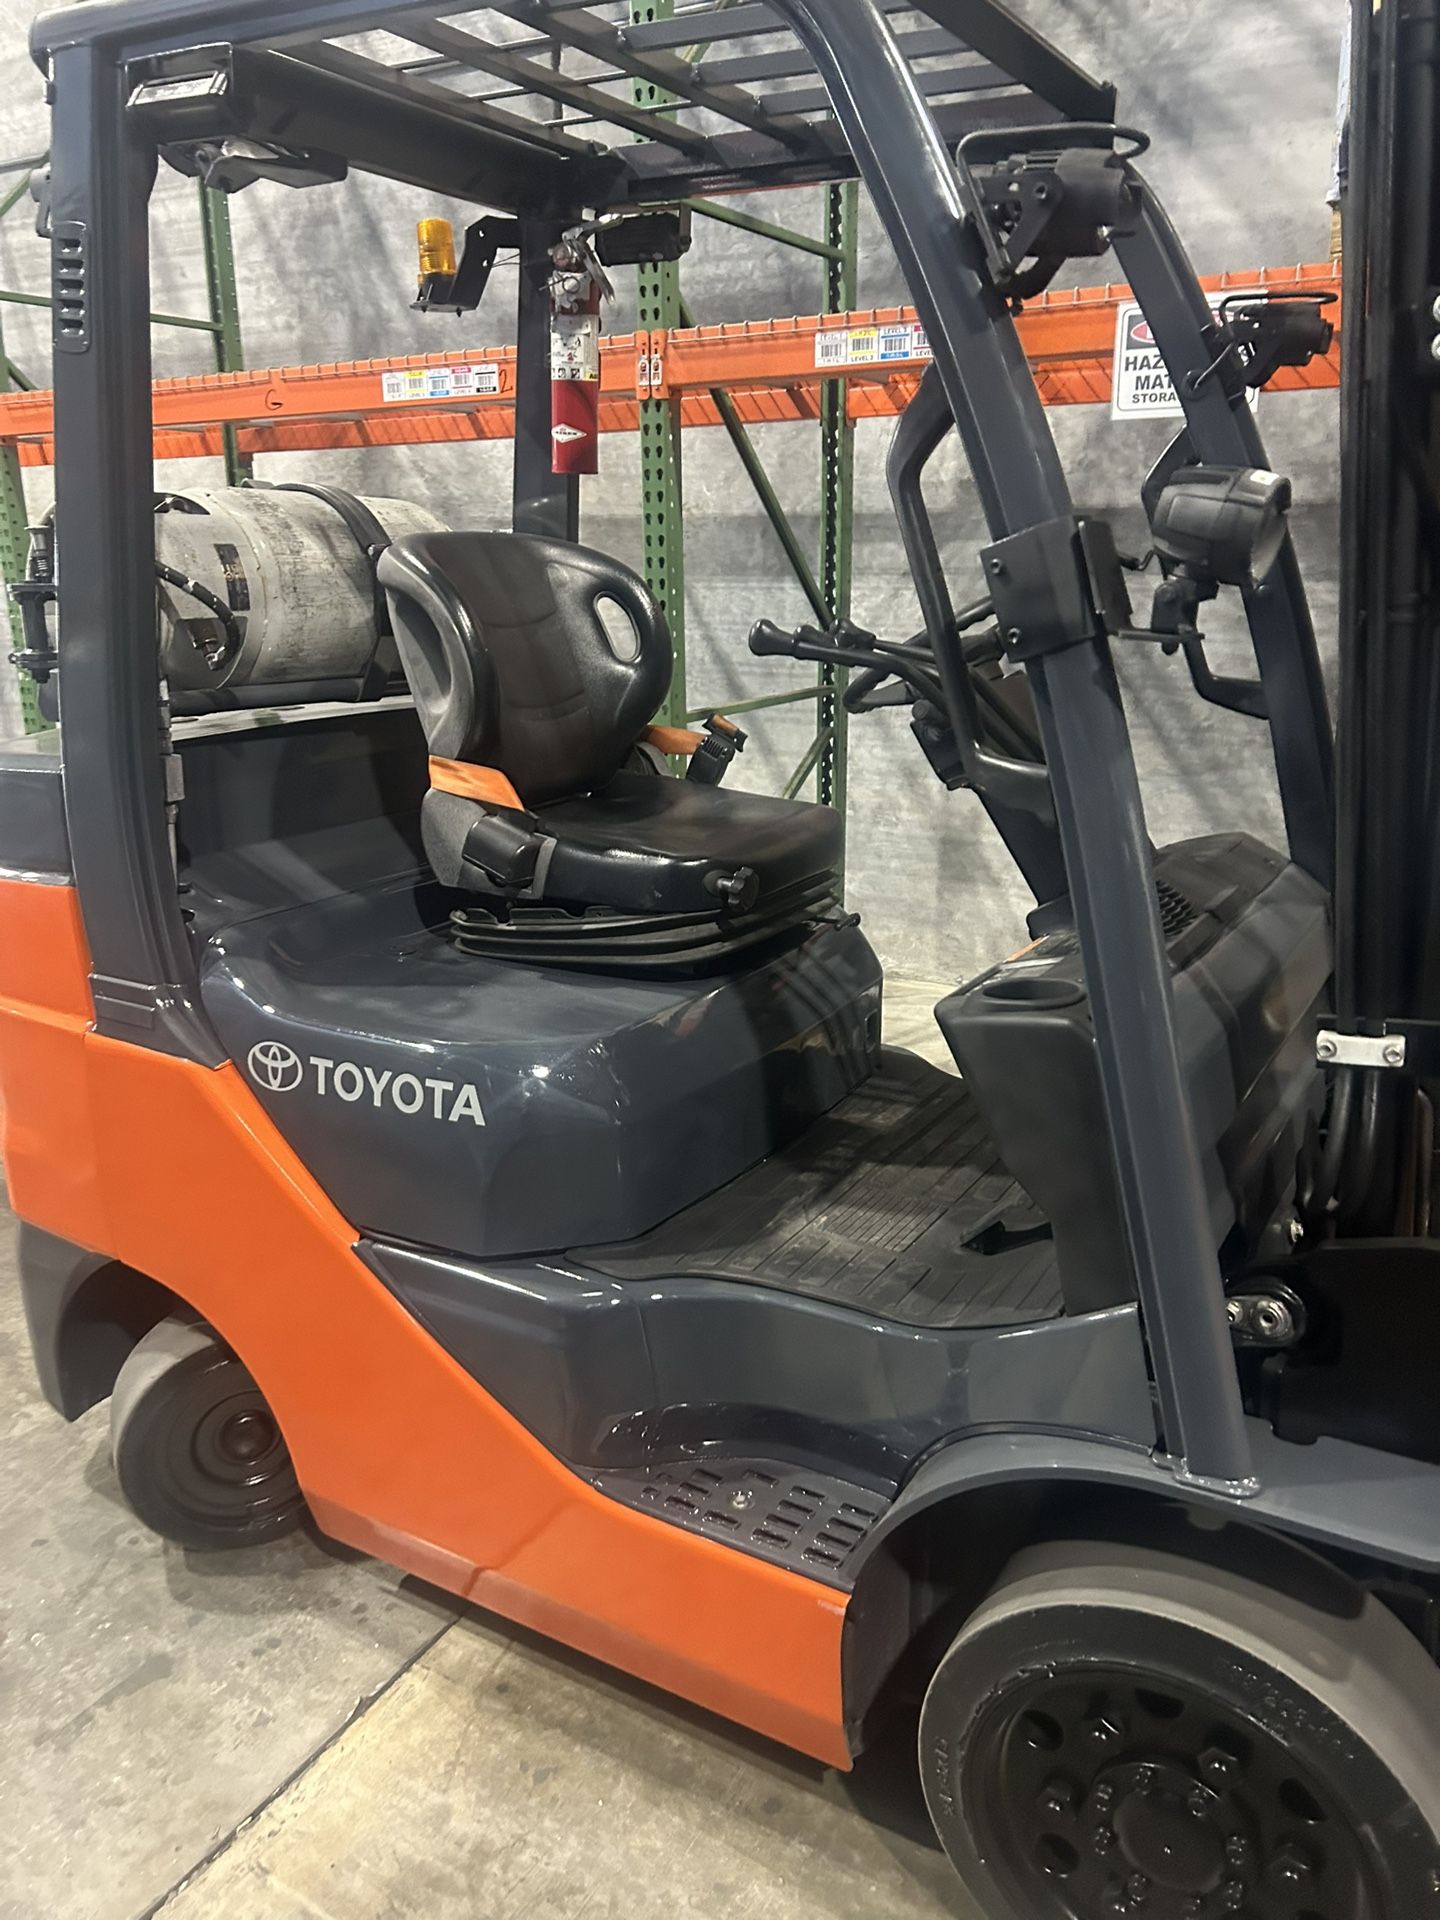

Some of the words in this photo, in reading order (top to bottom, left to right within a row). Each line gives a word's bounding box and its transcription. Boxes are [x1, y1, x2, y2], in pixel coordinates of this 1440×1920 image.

[499, 368, 513, 394] 2
[1132, 391, 1176, 404] STORA
[309, 1056, 486, 1126] TOYOTA
